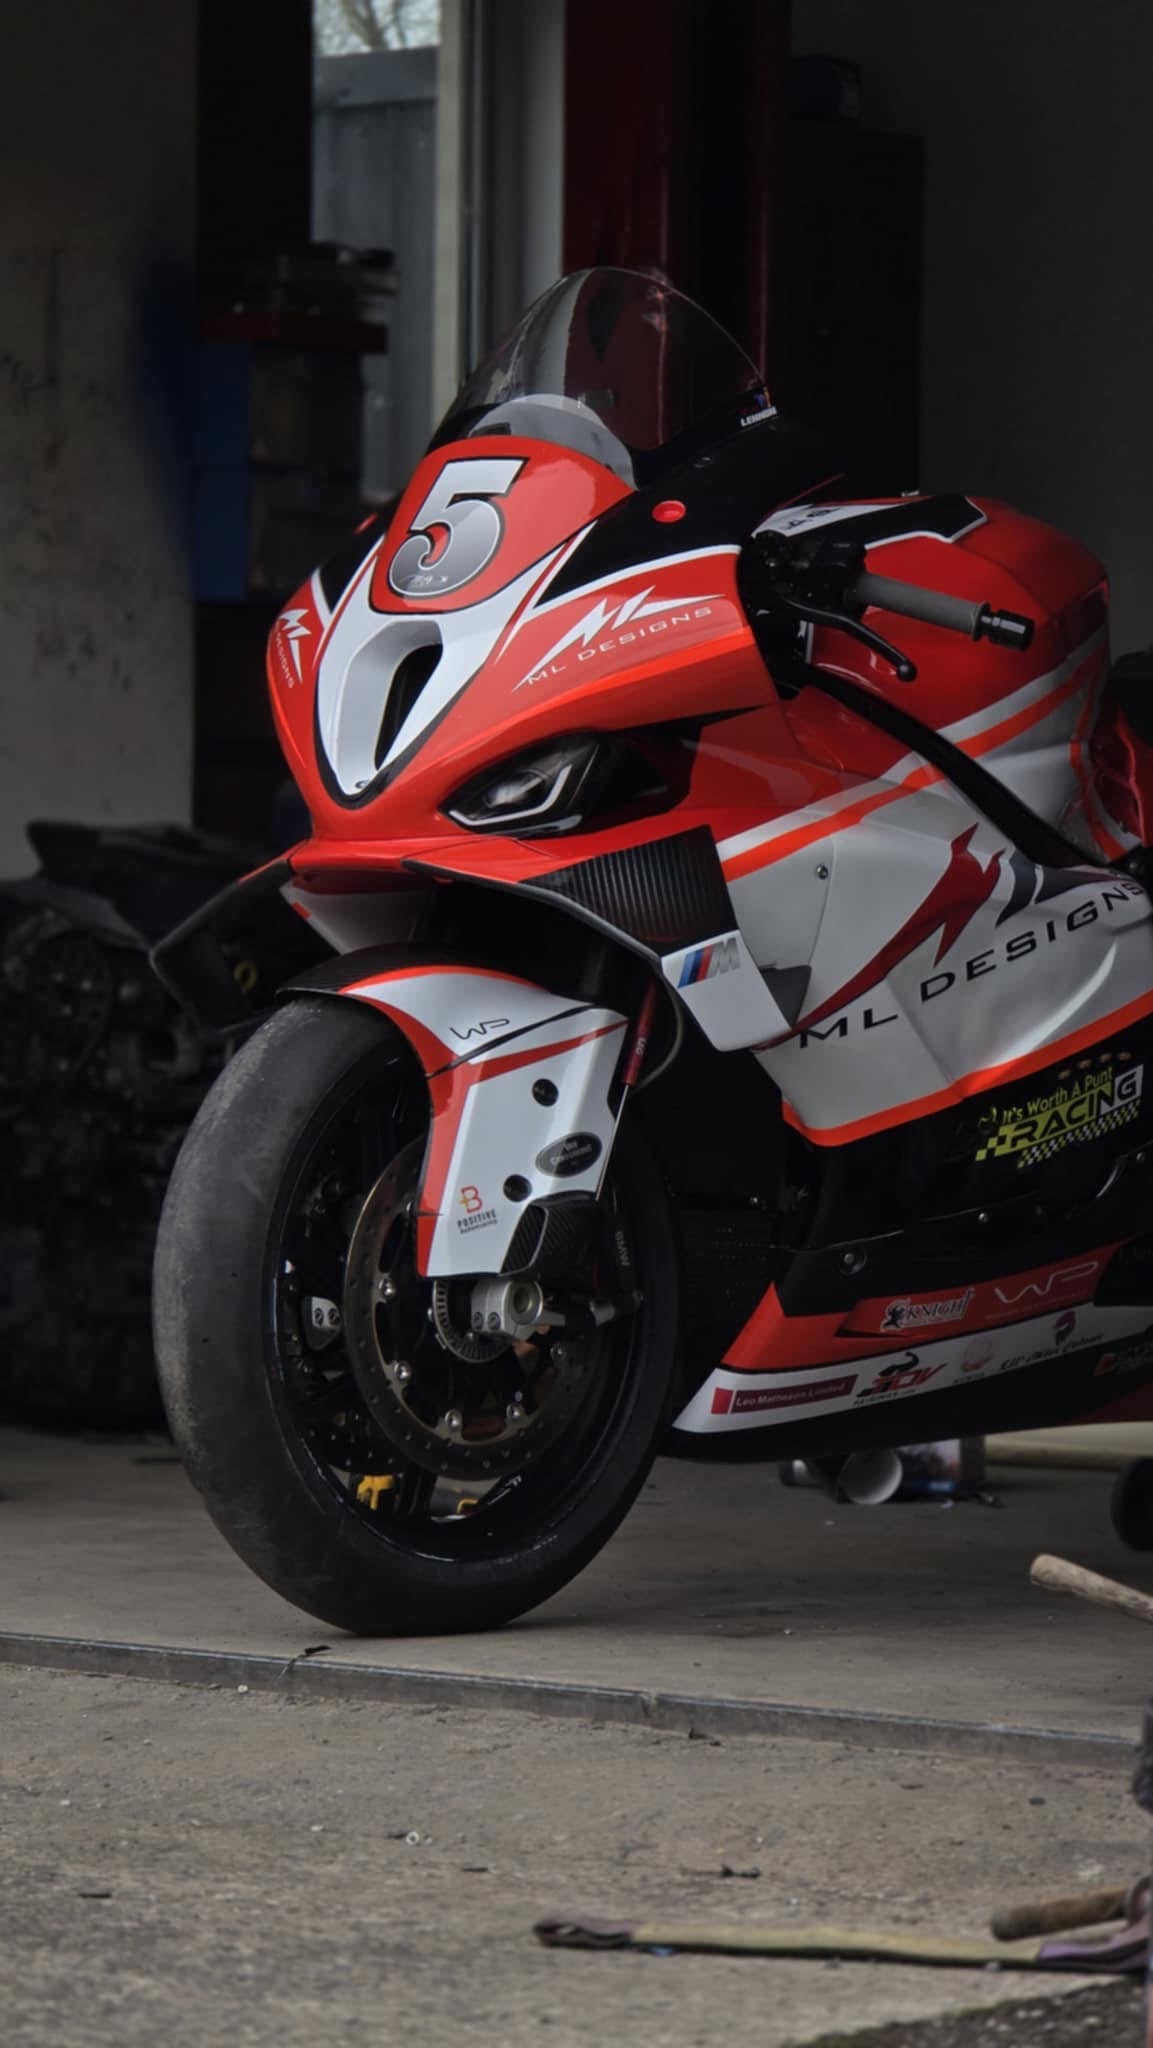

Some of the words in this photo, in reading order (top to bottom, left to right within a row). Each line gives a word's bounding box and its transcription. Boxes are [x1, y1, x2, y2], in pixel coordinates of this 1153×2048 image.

[388, 457, 529, 596] 5
[527, 665, 567, 685] ML
[577, 606, 712, 662] DESIGNS
[799, 1007, 898, 1049] ML
[920, 880, 1143, 1003] DESIGNS
[450, 1018, 510, 1040] WP
[1002, 1105, 1024, 1125] It's
[1026, 1087, 1068, 1116] Worth
[1071, 1081, 1082, 1098] A
[1084, 1066, 1113, 1093] Punt
[1009, 1070, 1140, 1150] RACING
[457, 1209, 497, 1228] POSITIVE
[994, 1261, 1099, 1304] WP
